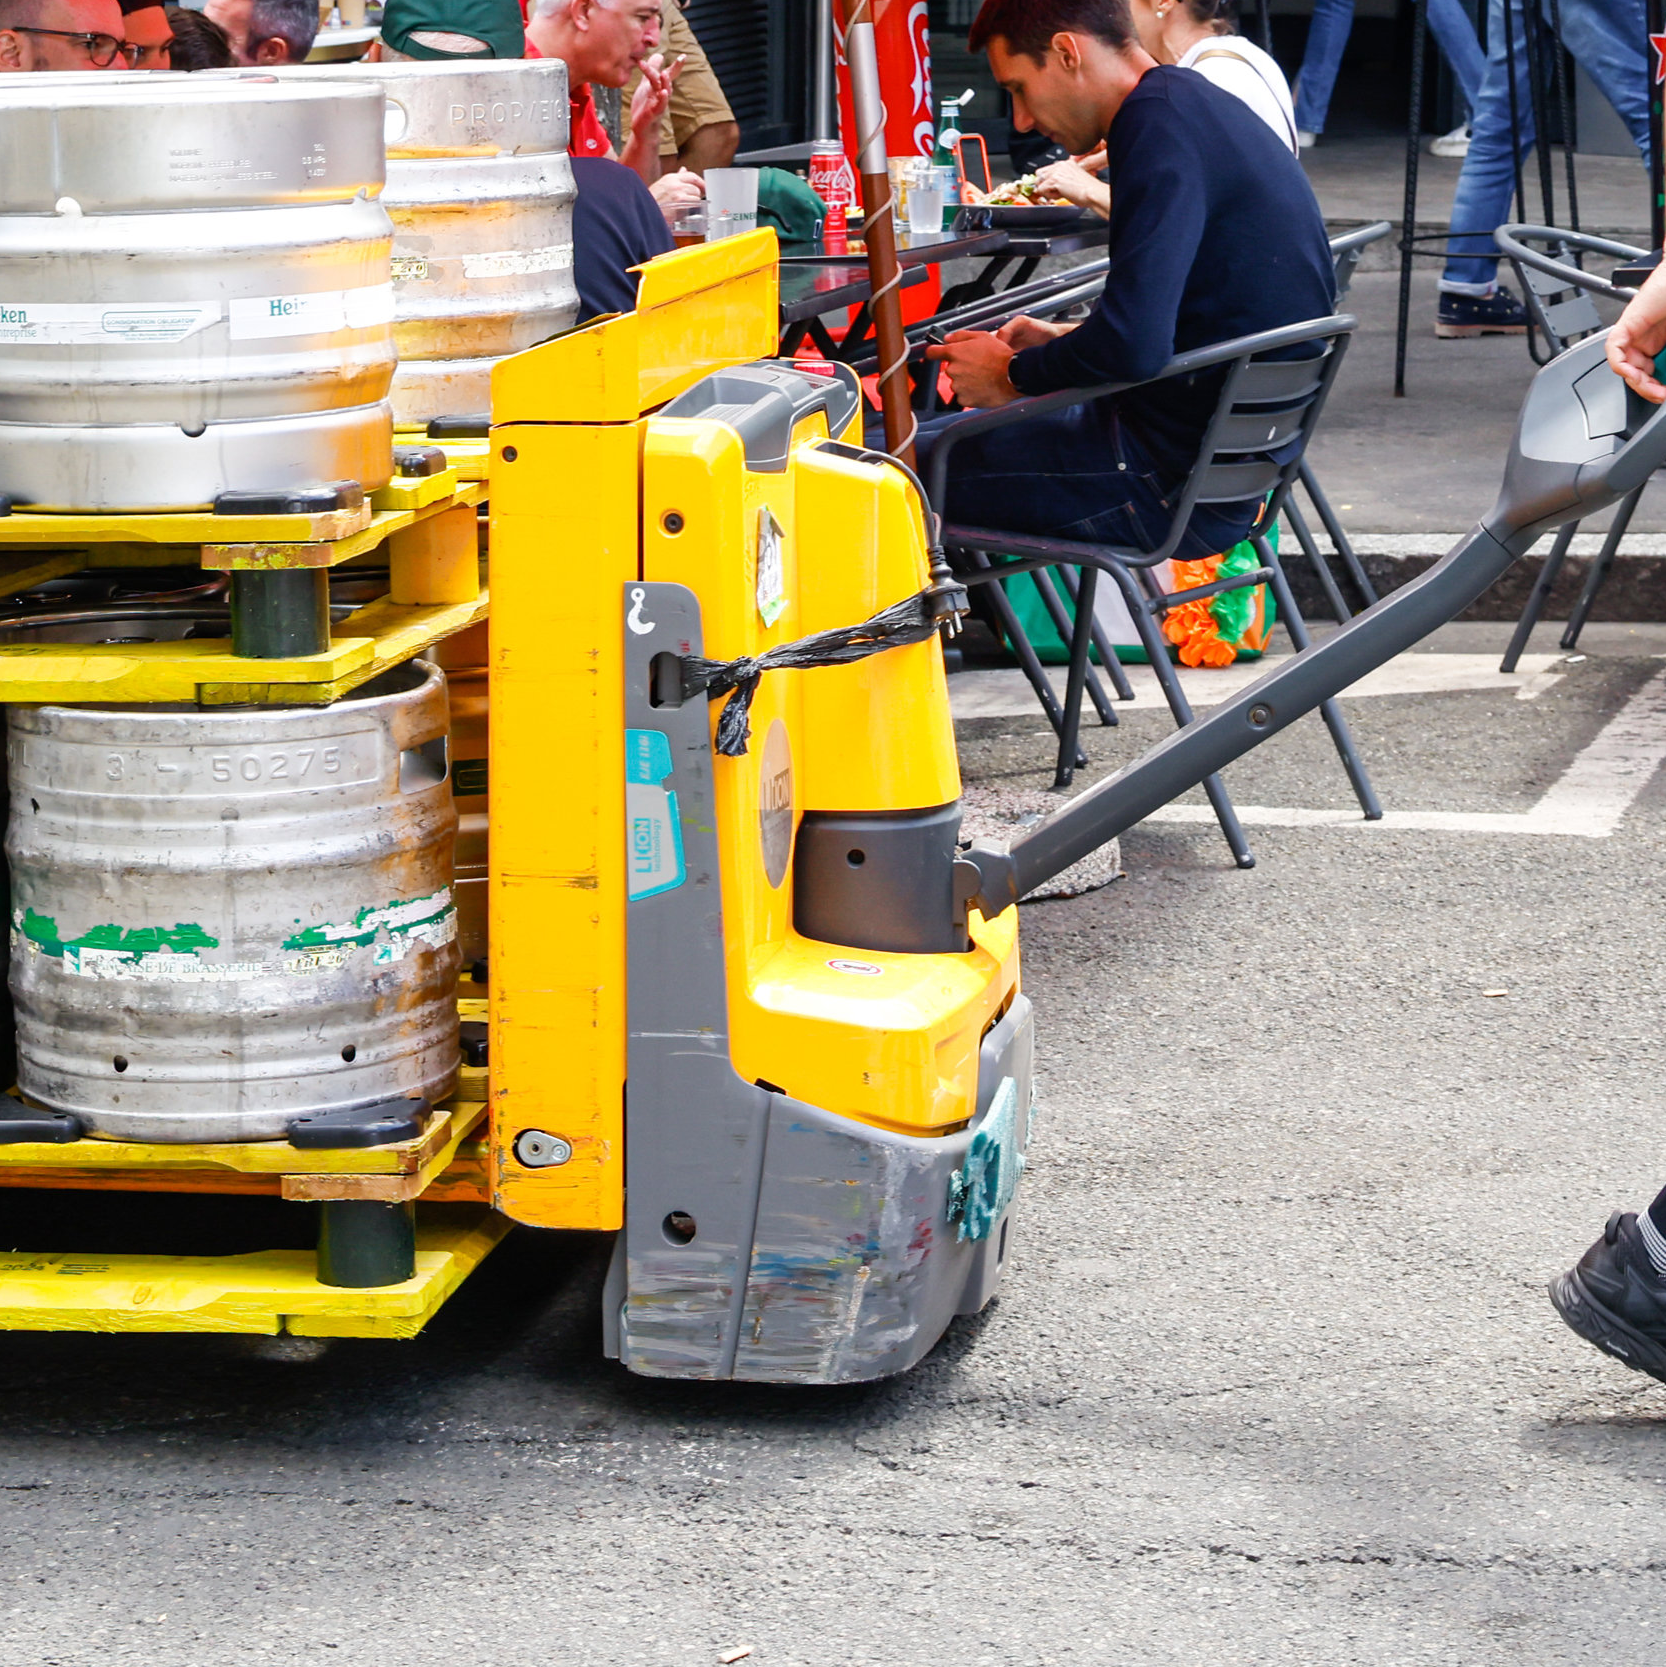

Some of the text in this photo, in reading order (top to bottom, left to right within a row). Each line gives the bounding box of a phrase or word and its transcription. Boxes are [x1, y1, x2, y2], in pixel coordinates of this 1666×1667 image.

[104, 753, 126, 781] 3
[211, 746, 343, 783] 50275
[653, 819, 662, 873] technology
